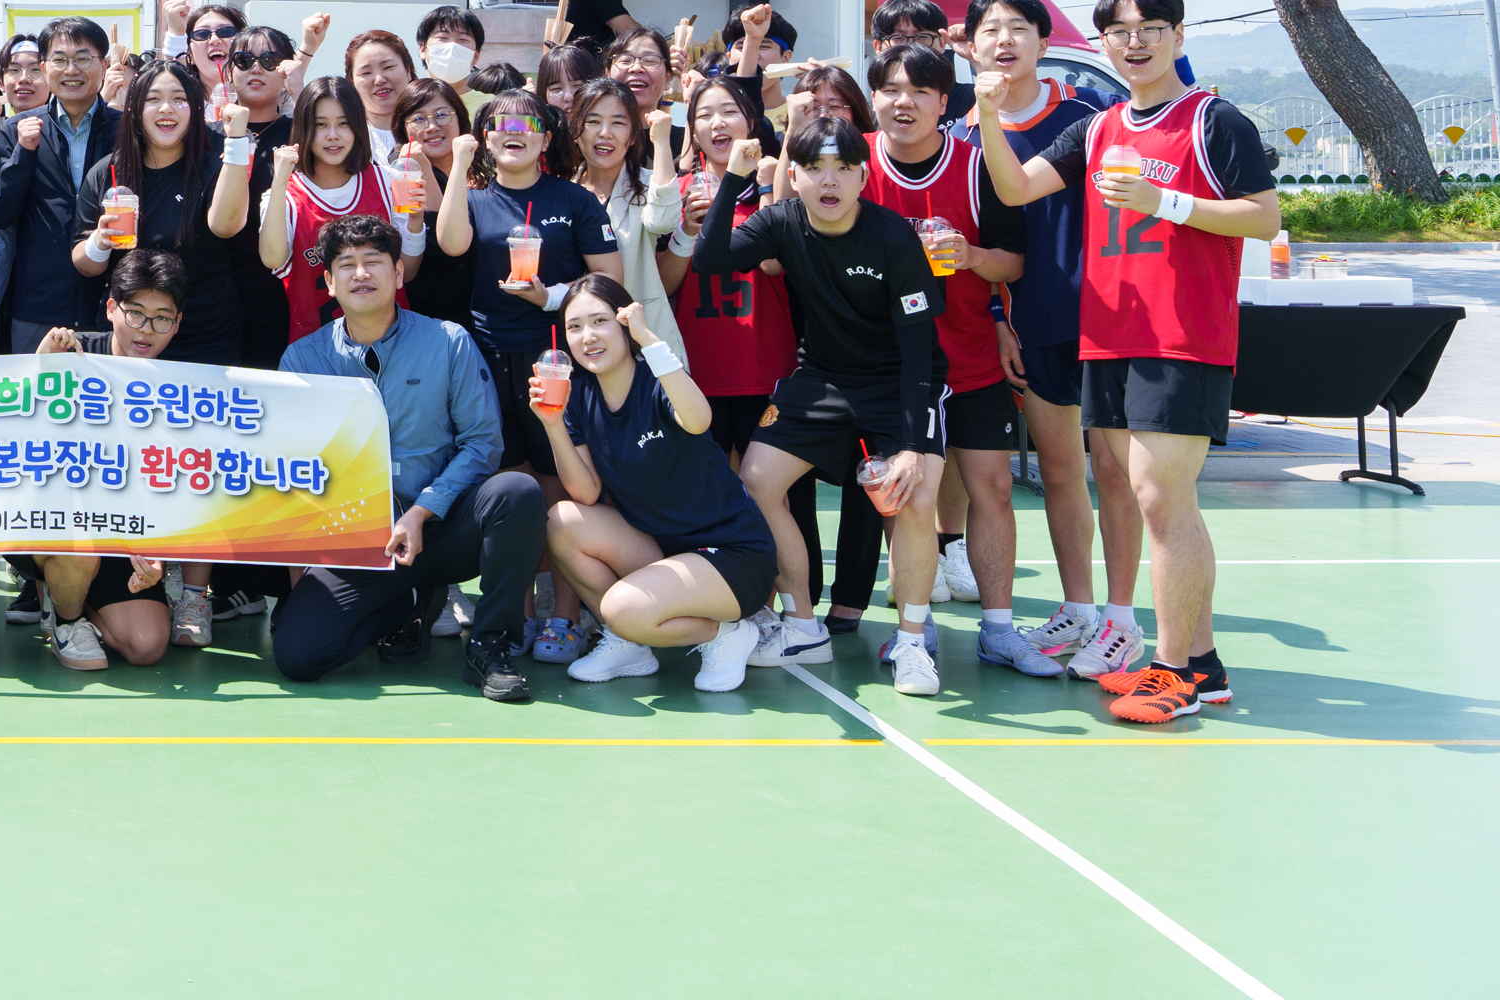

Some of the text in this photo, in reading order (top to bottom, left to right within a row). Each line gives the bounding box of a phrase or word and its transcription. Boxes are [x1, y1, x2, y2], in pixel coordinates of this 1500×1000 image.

[846, 265, 883, 281] R.O.K.A
[124, 381, 260, 431] 응원하는
[140, 445, 326, 492] 환영합니다
[72, 511, 155, 536] 학부모회-
